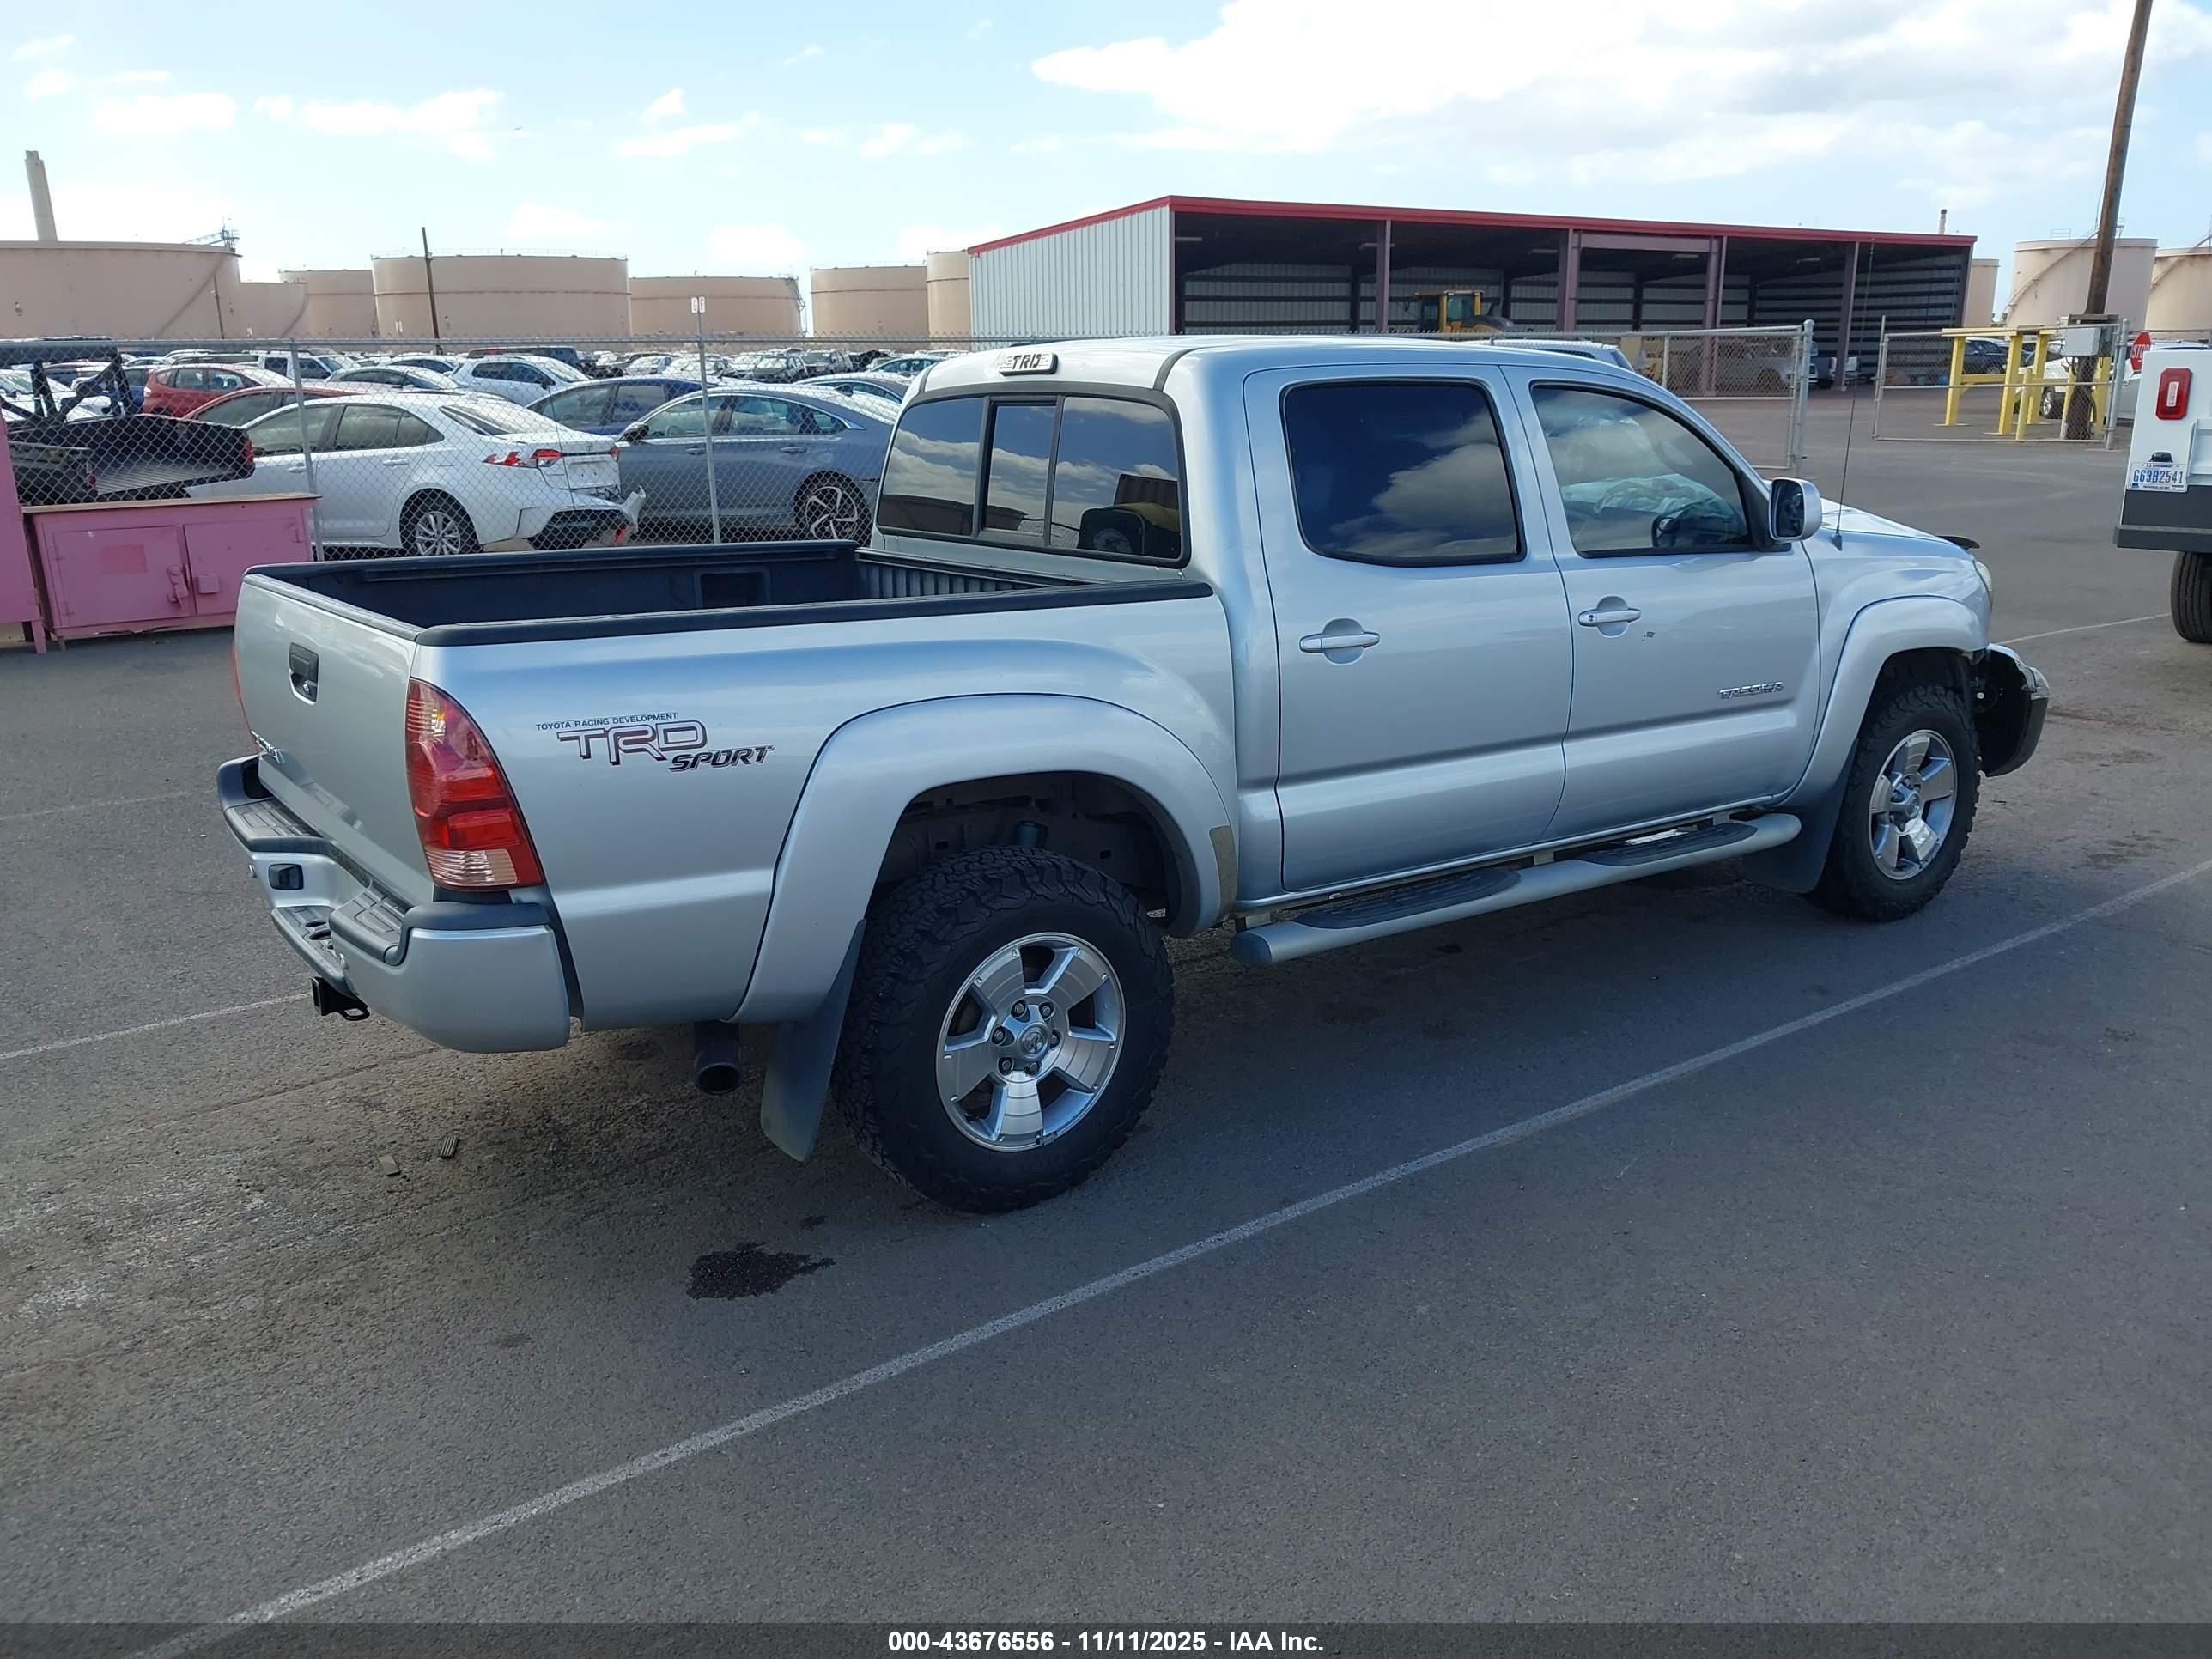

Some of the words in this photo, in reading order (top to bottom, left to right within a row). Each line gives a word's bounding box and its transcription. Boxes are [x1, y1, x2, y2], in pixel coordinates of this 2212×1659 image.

[2133, 469, 2184, 484] G63B2541
[536, 720, 572, 731] TOYOTA
[574, 717, 610, 727] RACING
[612, 712, 678, 725] DEVELOPMENT
[556, 720, 708, 766] TRD
[668, 745, 775, 773] SPORT
